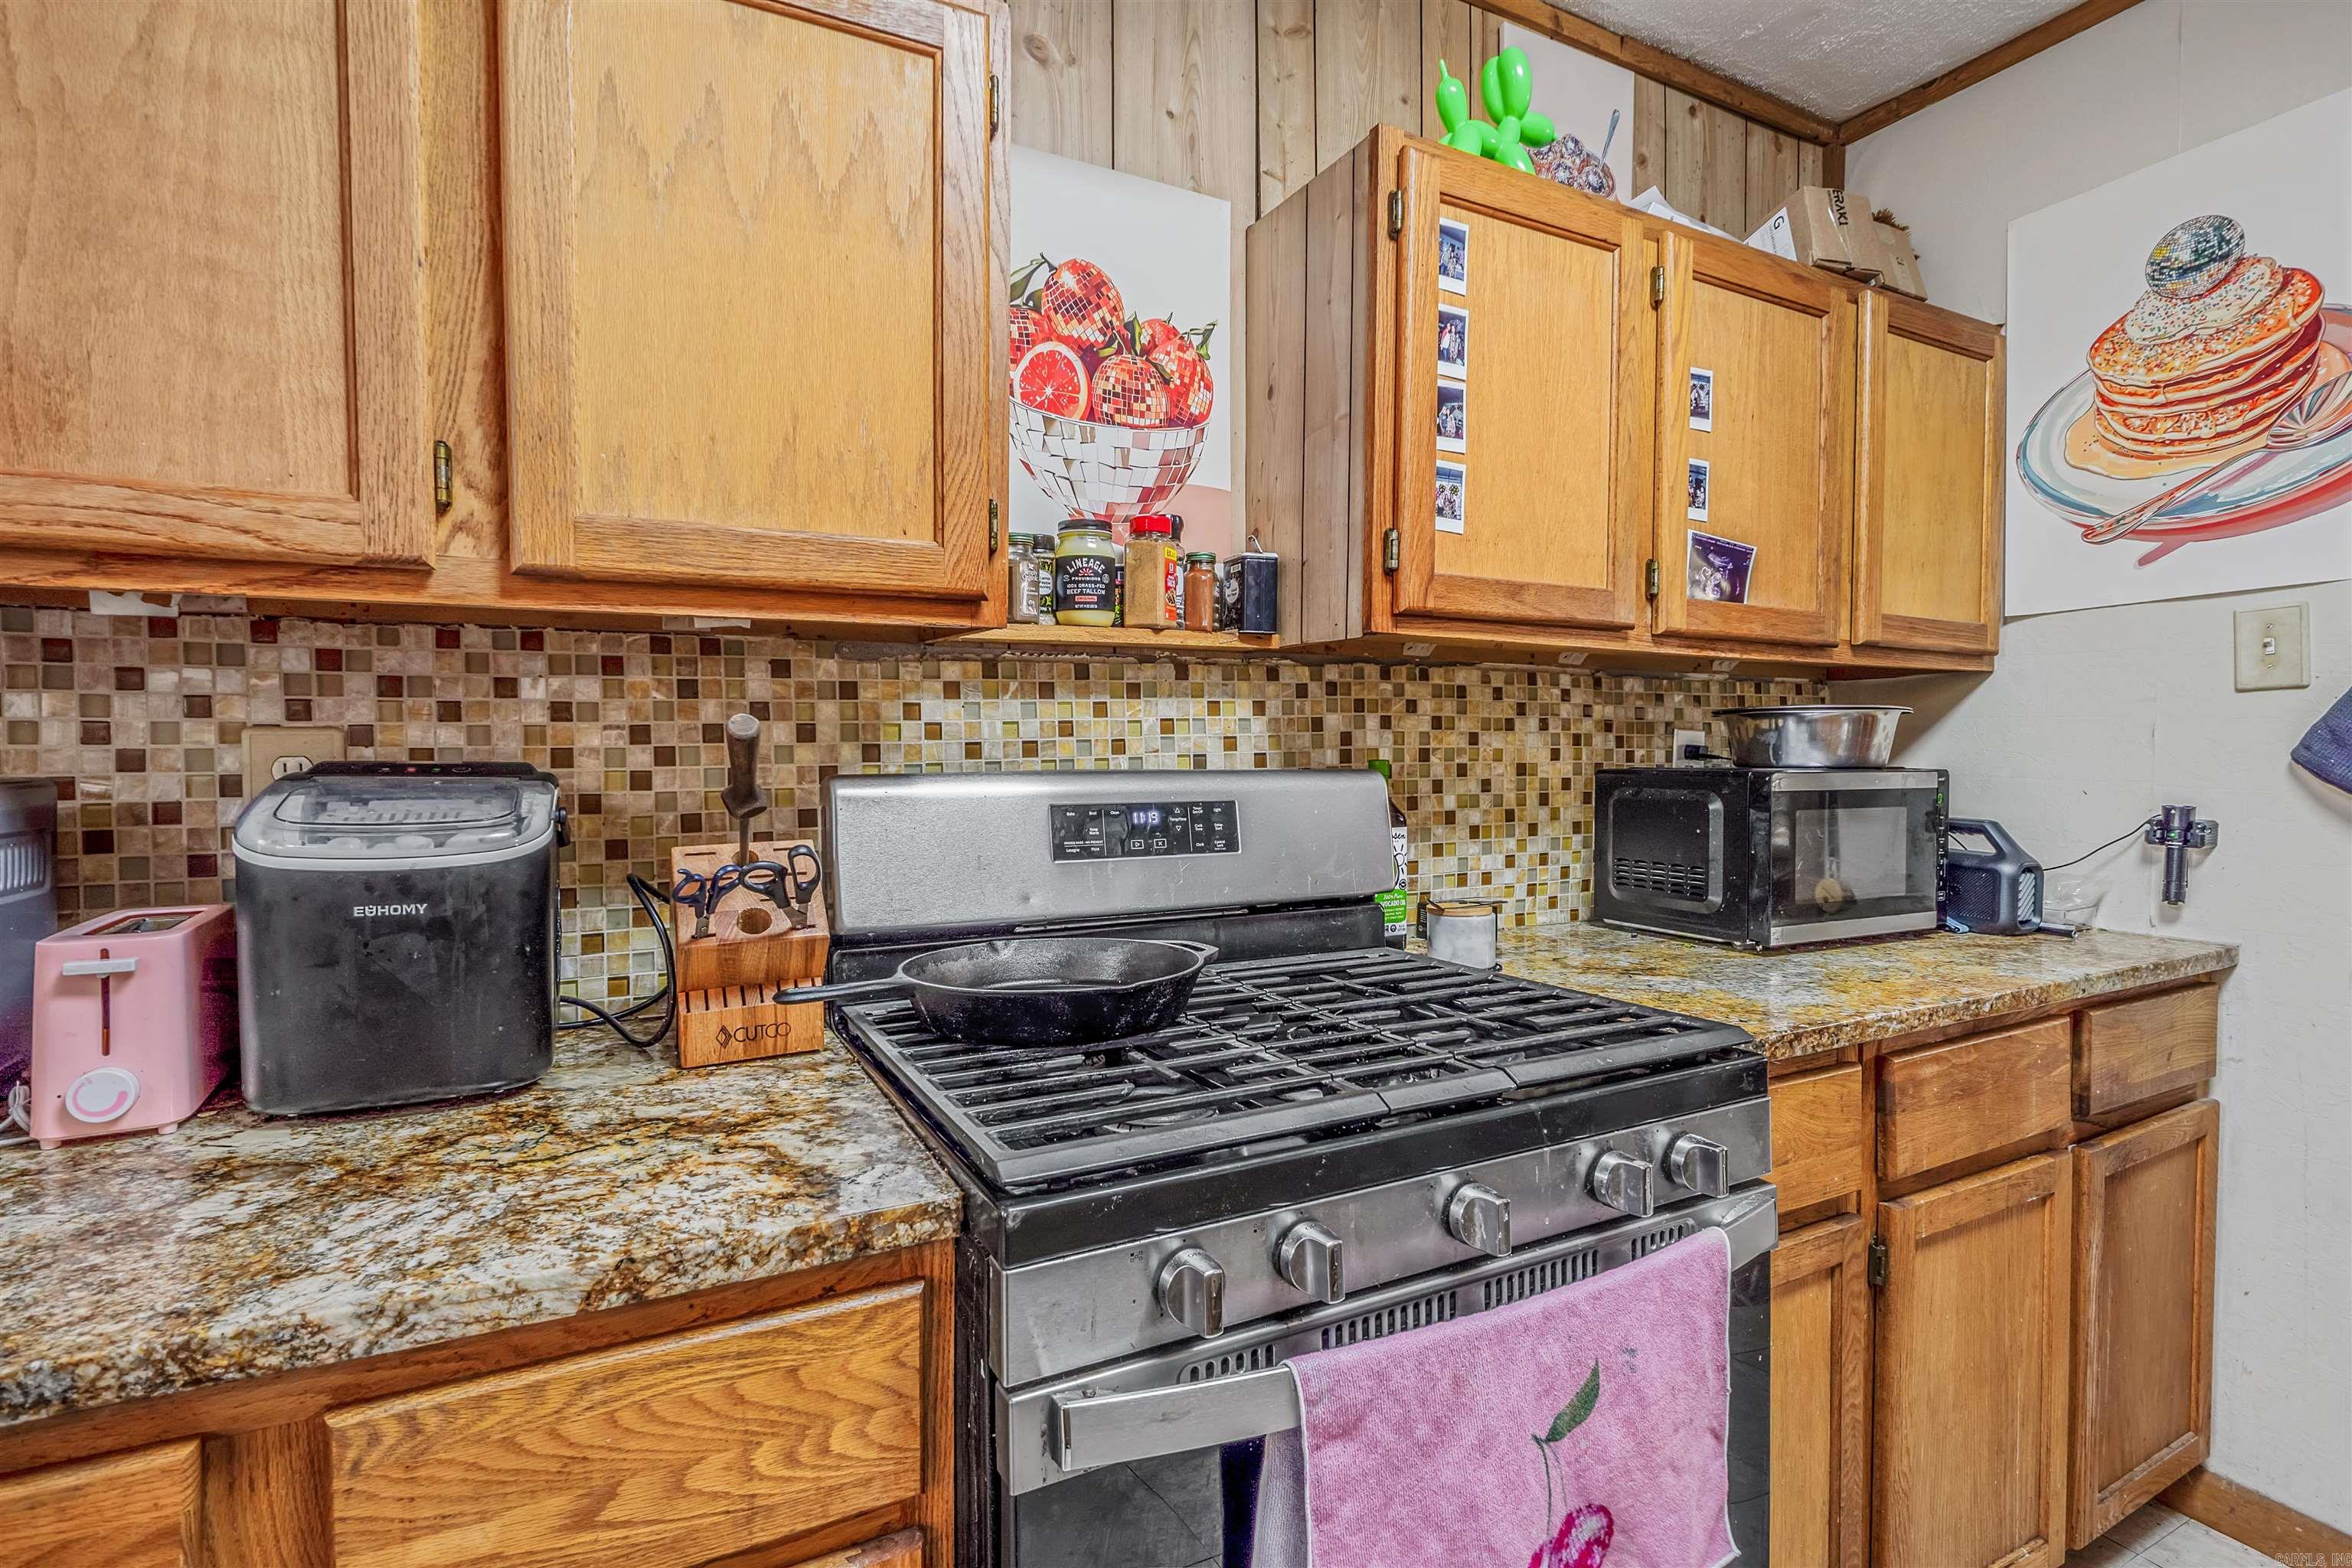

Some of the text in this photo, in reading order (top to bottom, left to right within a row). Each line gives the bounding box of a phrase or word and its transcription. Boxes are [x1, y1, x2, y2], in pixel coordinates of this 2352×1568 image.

[1773, 216, 1785, 230] G
[1067, 557, 1106, 573] LINEAGE
[1133, 812, 1158, 824] 11:19
[353, 903, 428, 916] EUHOMY
[733, 1022, 792, 1043] CUTCO
